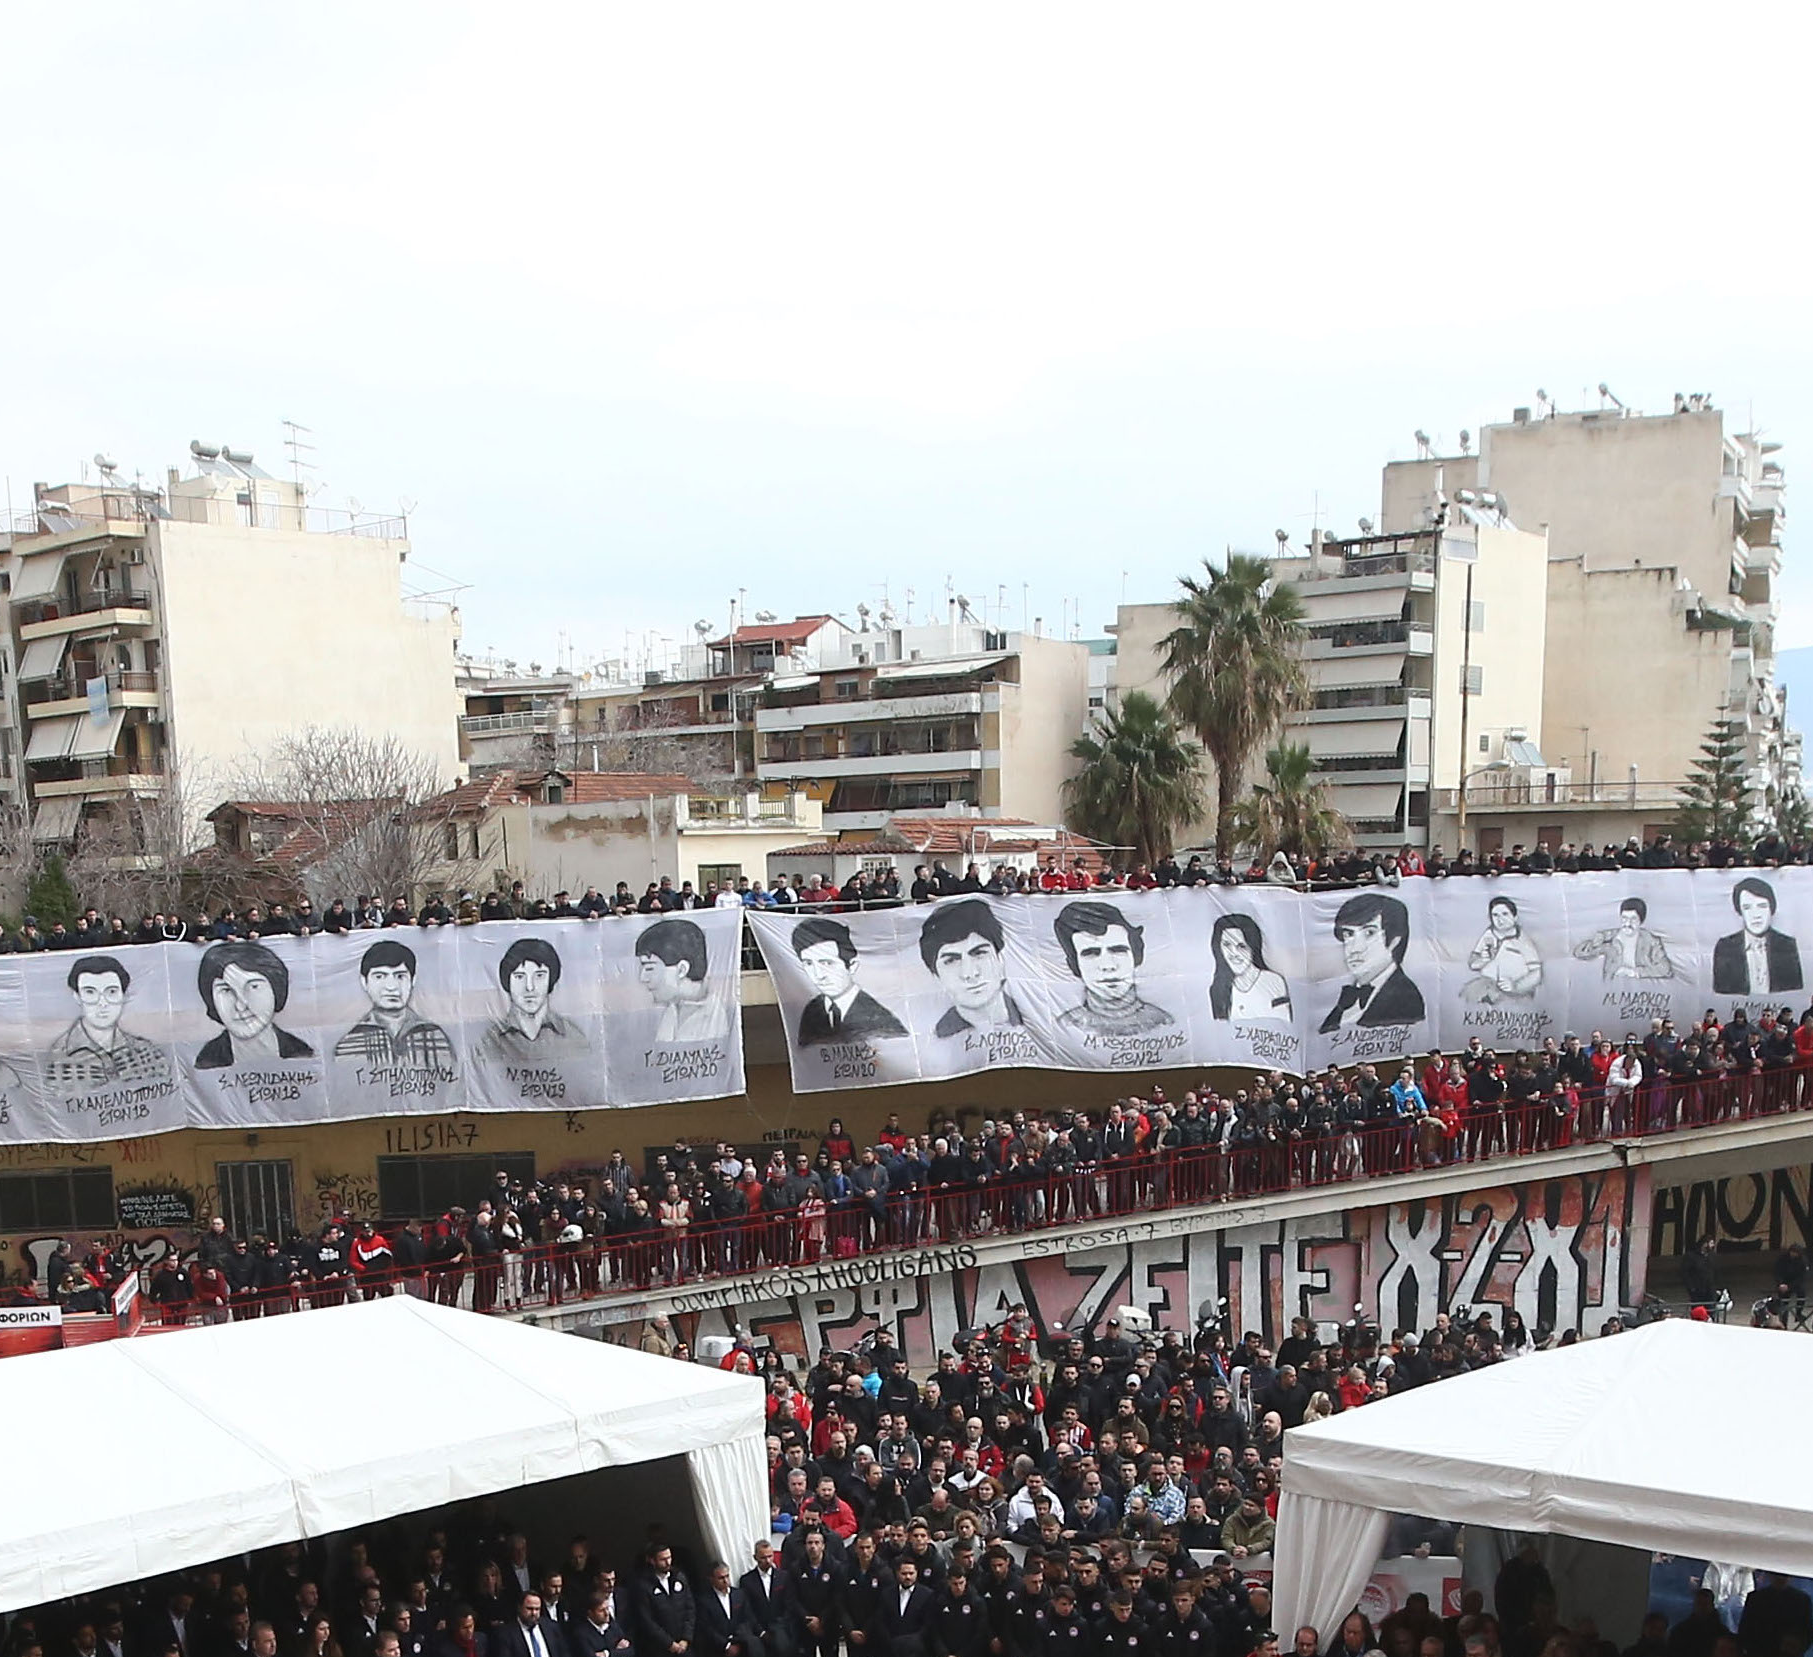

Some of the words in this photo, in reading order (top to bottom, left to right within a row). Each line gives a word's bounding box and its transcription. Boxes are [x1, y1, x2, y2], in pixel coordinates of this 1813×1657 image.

[1388, 1040, 1402, 1053] 24
[1146, 1050, 1163, 1063] 21
[701, 1063, 718, 1078] 20
[861, 1063, 876, 1077] 20
[282, 1086, 300, 1100] 18
[134, 1104, 151, 1118] 18
[834, 1244, 978, 1289] HOOLIGANS
